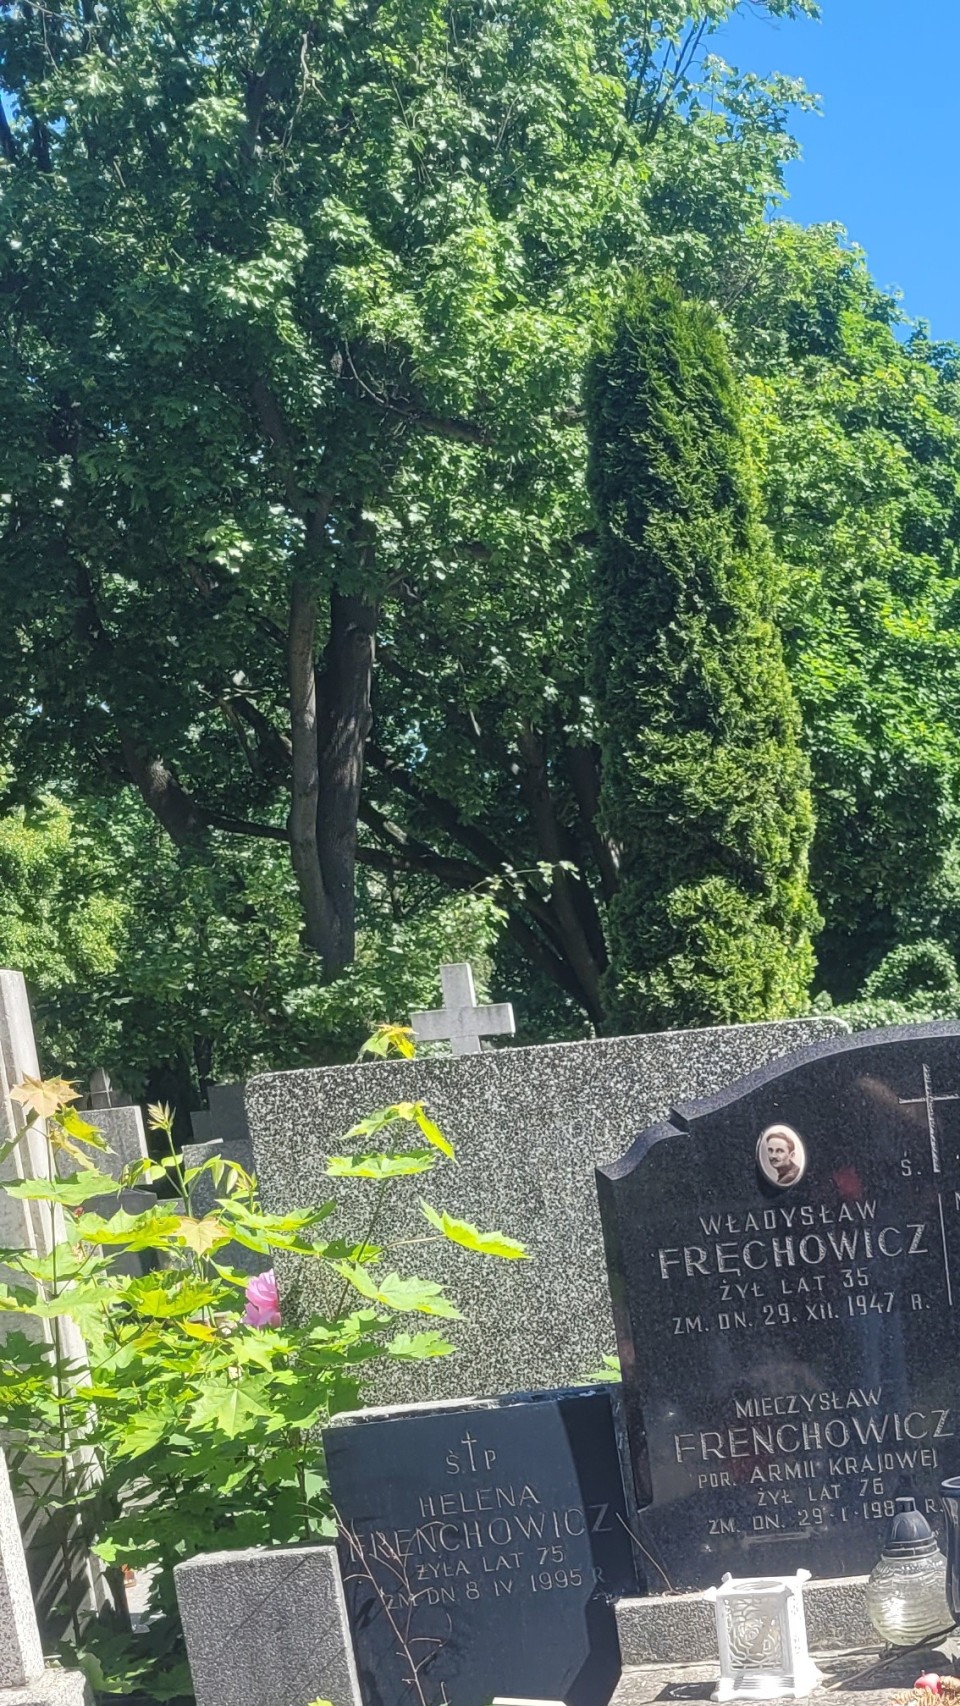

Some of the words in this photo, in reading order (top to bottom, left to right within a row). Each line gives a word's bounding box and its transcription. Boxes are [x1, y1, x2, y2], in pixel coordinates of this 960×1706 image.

[700, 1200, 877, 1236] WŁADYSŁAW
[658, 1223, 928, 1279] FRĘCHOWICZ
[719, 1280, 764, 1301] ŻYŁ
[782, 1276, 826, 1295] LAT
[841, 1267, 870, 1288] 35
[673, 1317, 709, 1335] ZM.
[763, 1303, 797, 1326] 29.
[848, 1292, 895, 1317] 1947
[735, 1387, 882, 1419] MIECZYSŁAW
[674, 1408, 954, 1463] FRENCHOWICZ
[484, 1450, 497, 1470] P
[698, 1471, 737, 1489] POR.
[750, 1459, 816, 1484] ARMII
[829, 1449, 940, 1476] KRAJOWEJ
[420, 1485, 540, 1517] HELENA
[757, 1487, 793, 1507] ŻYŁ
[808, 1484, 842, 1502] LAT
[859, 1477, 884, 1497] 76
[483, 1552, 525, 1572] LAT
[537, 1546, 565, 1565] 75
[427, 1587, 455, 1605] DN
[466, 1581, 480, 1600] 8
[494, 1579, 513, 1597] IV
[530, 1568, 583, 1592] 1995
